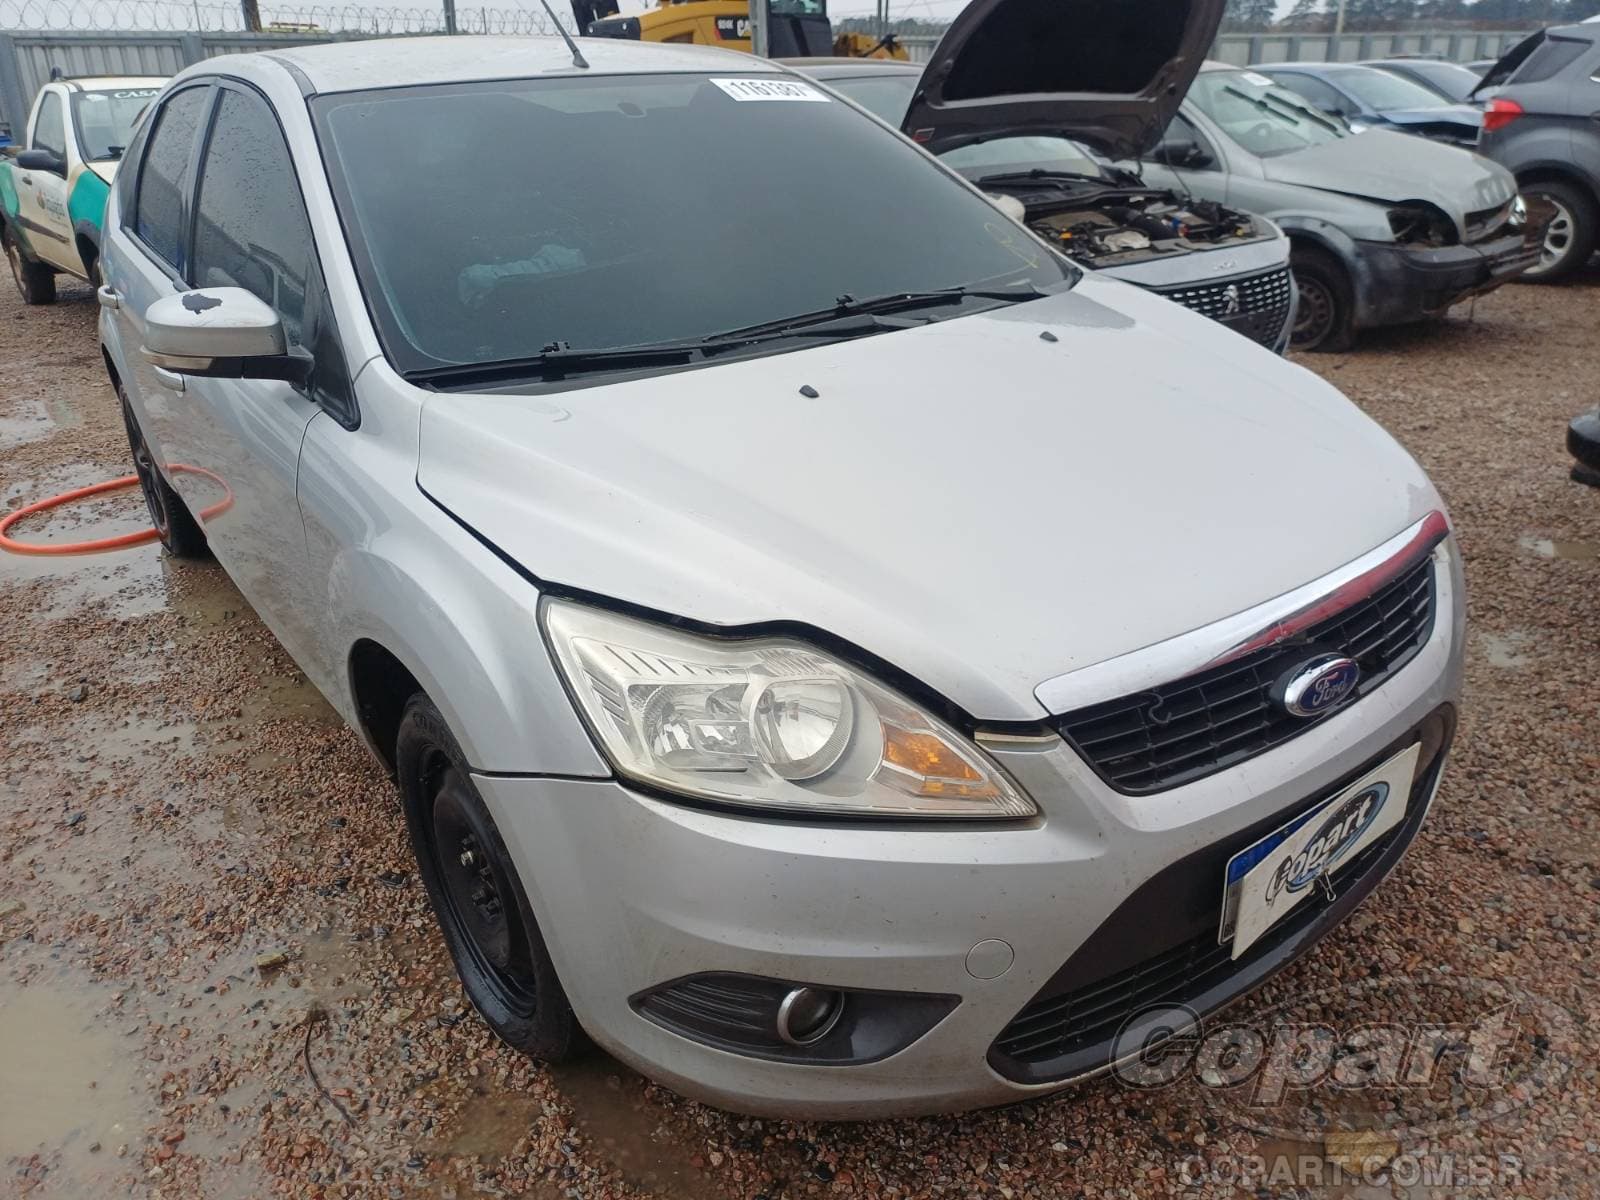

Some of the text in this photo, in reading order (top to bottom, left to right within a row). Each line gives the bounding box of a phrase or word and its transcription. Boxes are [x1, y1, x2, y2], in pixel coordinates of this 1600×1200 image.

[737, 20, 752, 37] CA
[1312, 671, 1348, 706] Ford
[1265, 795, 1373, 908] Copart
